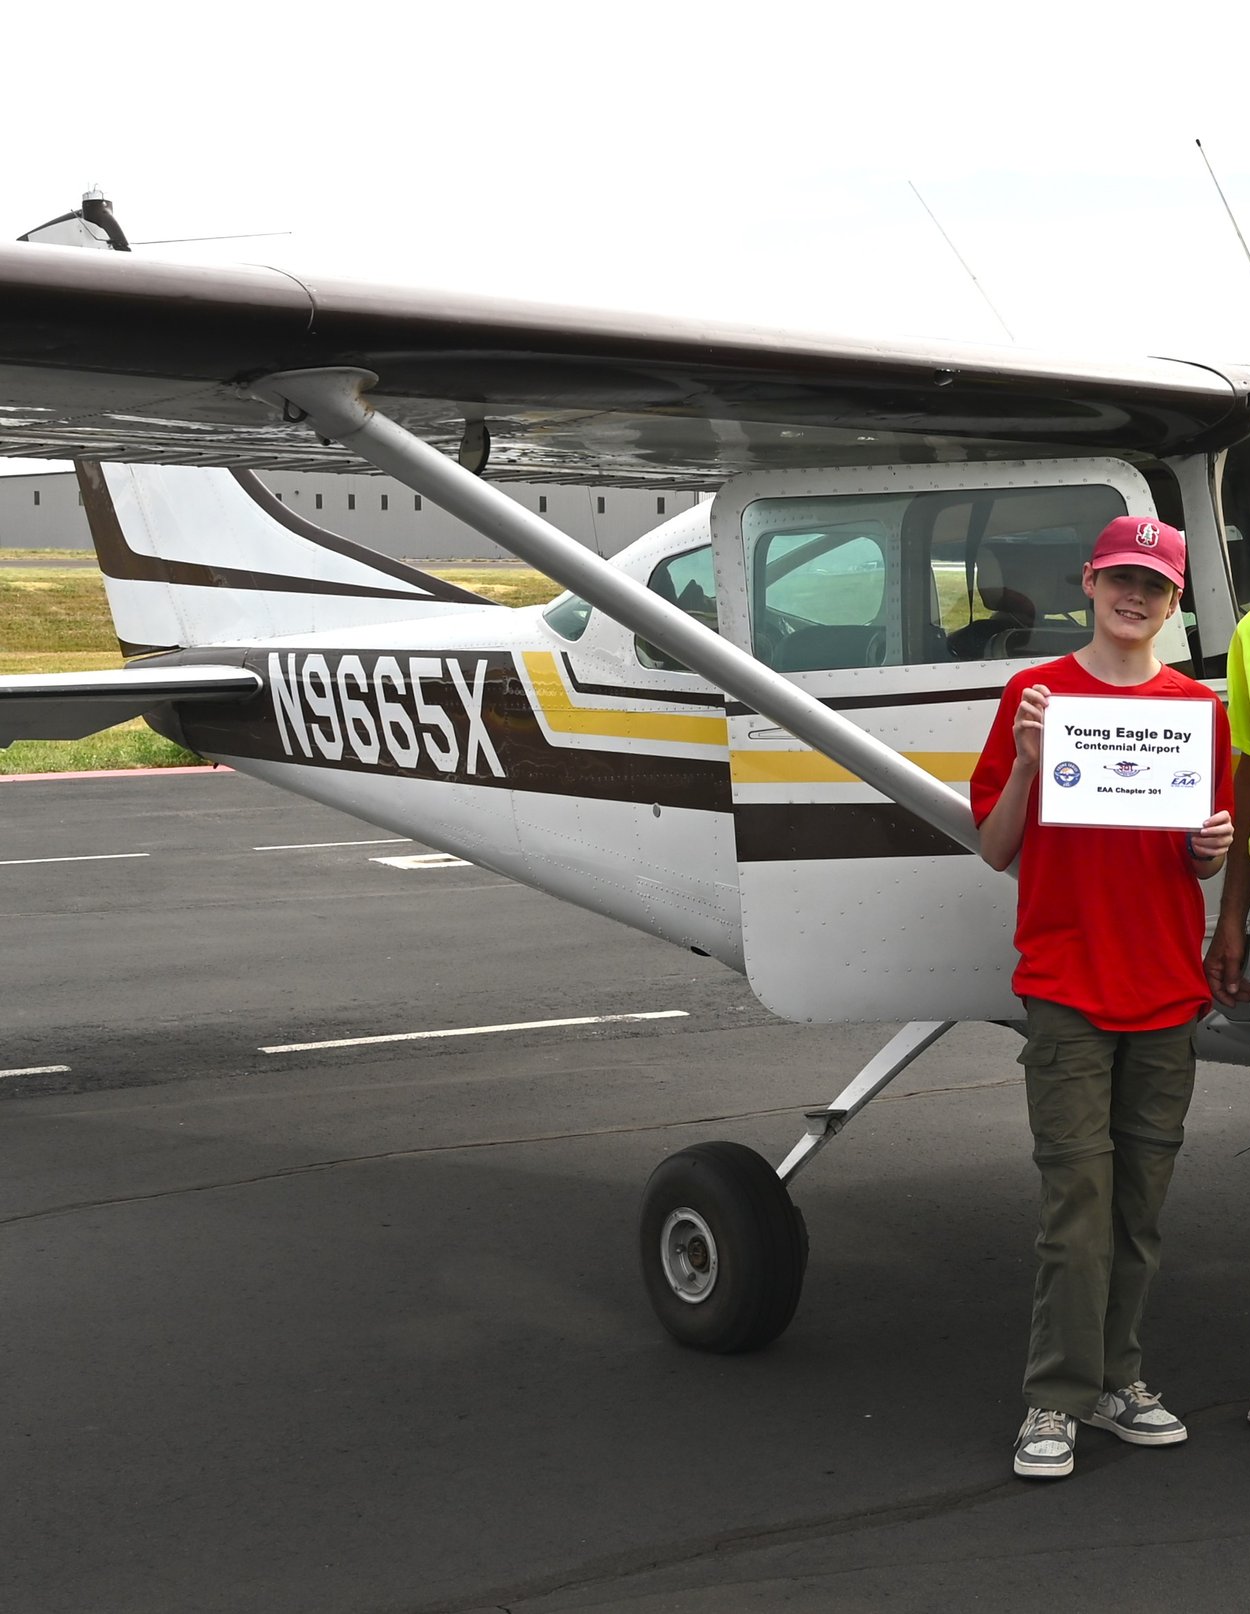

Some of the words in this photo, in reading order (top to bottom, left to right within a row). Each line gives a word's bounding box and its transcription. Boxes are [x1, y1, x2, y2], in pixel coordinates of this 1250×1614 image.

[268, 652, 506, 778] N9665X
[1064, 725, 1111, 740] Young
[1116, 727, 1158, 742] Eagle
[1163, 729, 1192, 743] Day
[1075, 741, 1136, 752] Centennial
[1140, 743, 1180, 754] Airport
[1171, 777, 1195, 785] EAA
[1115, 787, 1146, 795] Chapter
